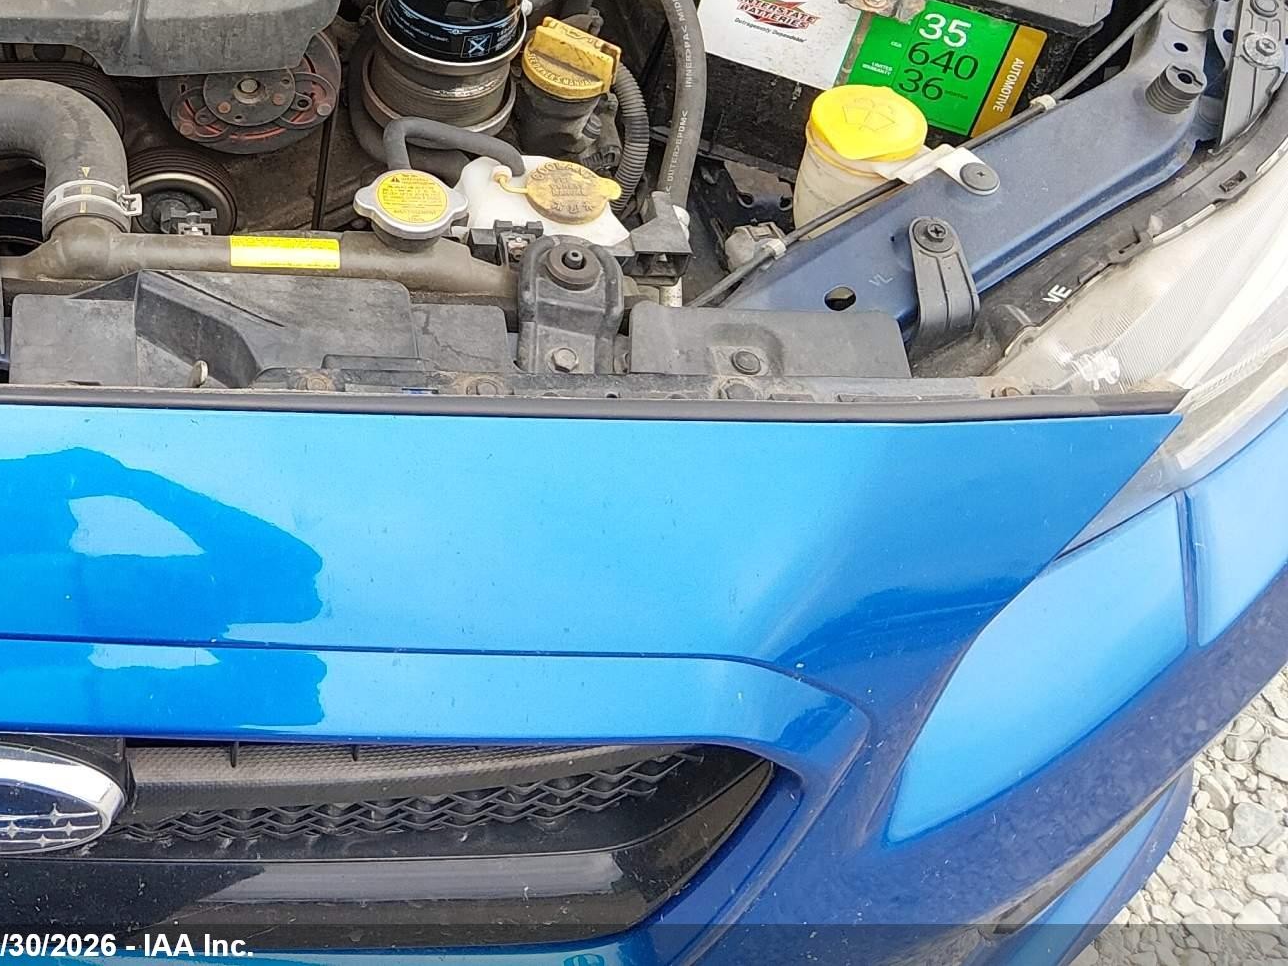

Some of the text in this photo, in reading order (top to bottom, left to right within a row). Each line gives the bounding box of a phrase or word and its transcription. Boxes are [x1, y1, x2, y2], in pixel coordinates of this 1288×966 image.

[738, 3, 810, 30] BATTERIES
[919, 13, 971, 48] 35
[907, 41, 979, 81] 640
[898, 68, 943, 100] 36
[992, 57, 1025, 113] AUTOMOTIVE
[1041, 283, 1073, 303] VE
